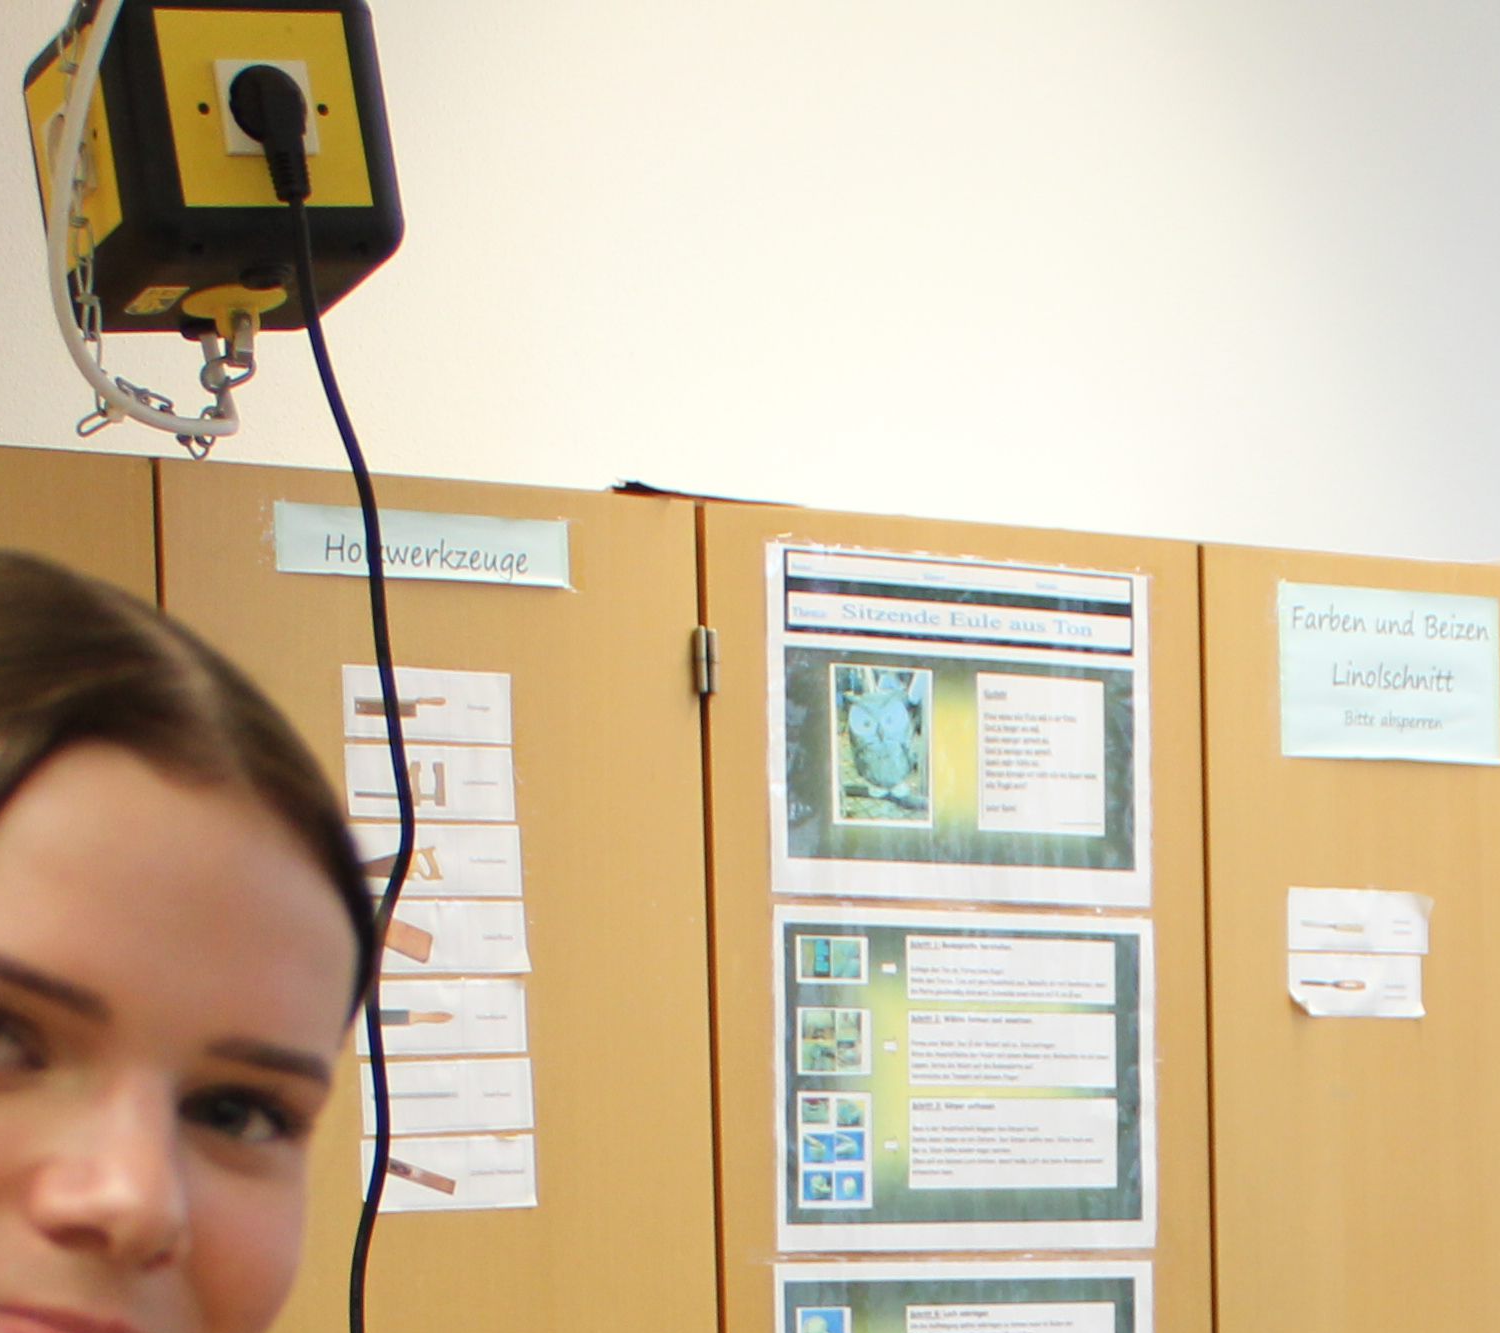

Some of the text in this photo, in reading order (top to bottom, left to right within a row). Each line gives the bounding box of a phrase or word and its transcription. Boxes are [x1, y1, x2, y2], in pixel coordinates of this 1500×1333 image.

[325, 534, 529, 582] Howerkzeuge
[841, 603, 941, 626] Sitzende
[950, 611, 1002, 630] Eule
[1008, 620, 1046, 634] aus
[1052, 618, 1094, 638] Ton
[1291, 604, 1490, 641] Farben und Beizen
[1331, 660, 1455, 693] Linolschnitt
[1343, 710, 1443, 733] Bitte absperren
